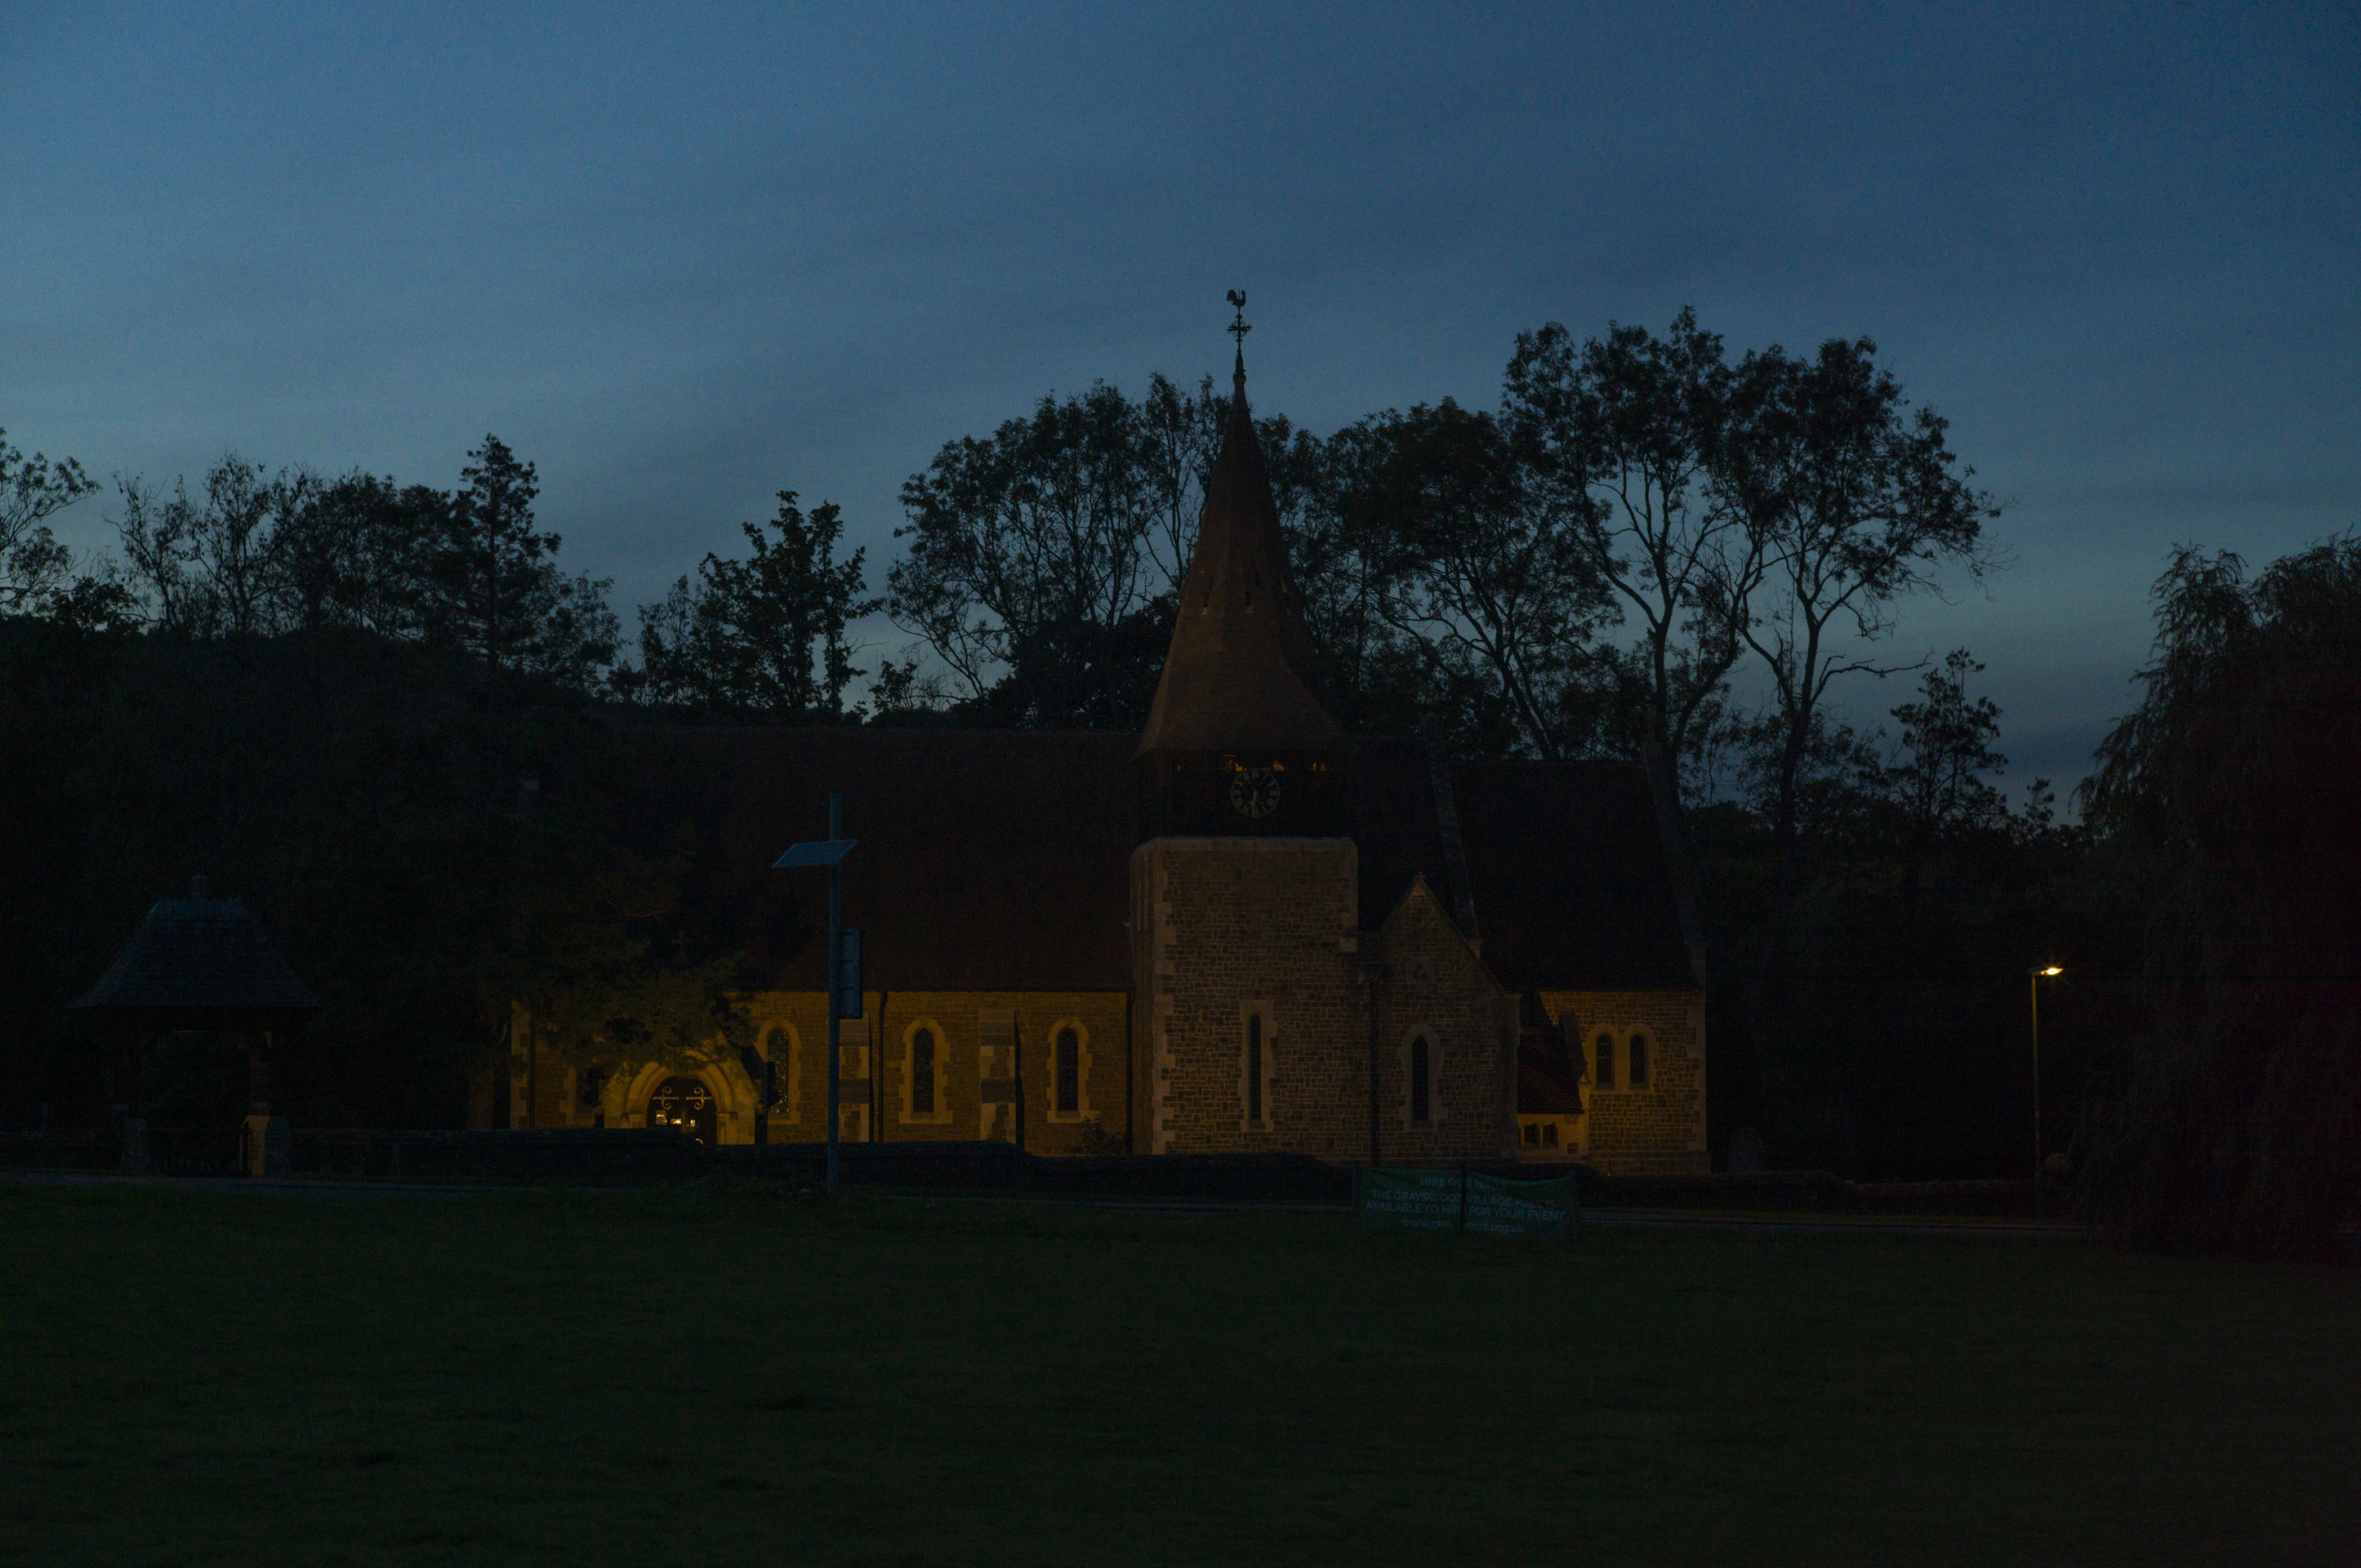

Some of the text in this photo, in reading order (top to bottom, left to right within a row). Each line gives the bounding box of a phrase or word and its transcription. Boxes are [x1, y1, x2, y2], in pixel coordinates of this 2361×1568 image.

[1420, 1177, 1446, 1187] HIRE
[1371, 1189, 1391, 1200] THE
[1466, 1194, 1512, 1207] VILLAGE
[1546, 1200, 1557, 1209] IS
[1365, 1200, 1422, 1214] AVAILABLE
[1423, 1204, 1439, 1214] TO
[1468, 1206, 1491, 1217] FOR
[1493, 1208, 1525, 1218] YOUR
[1526, 1209, 1566, 1221] EVENT
